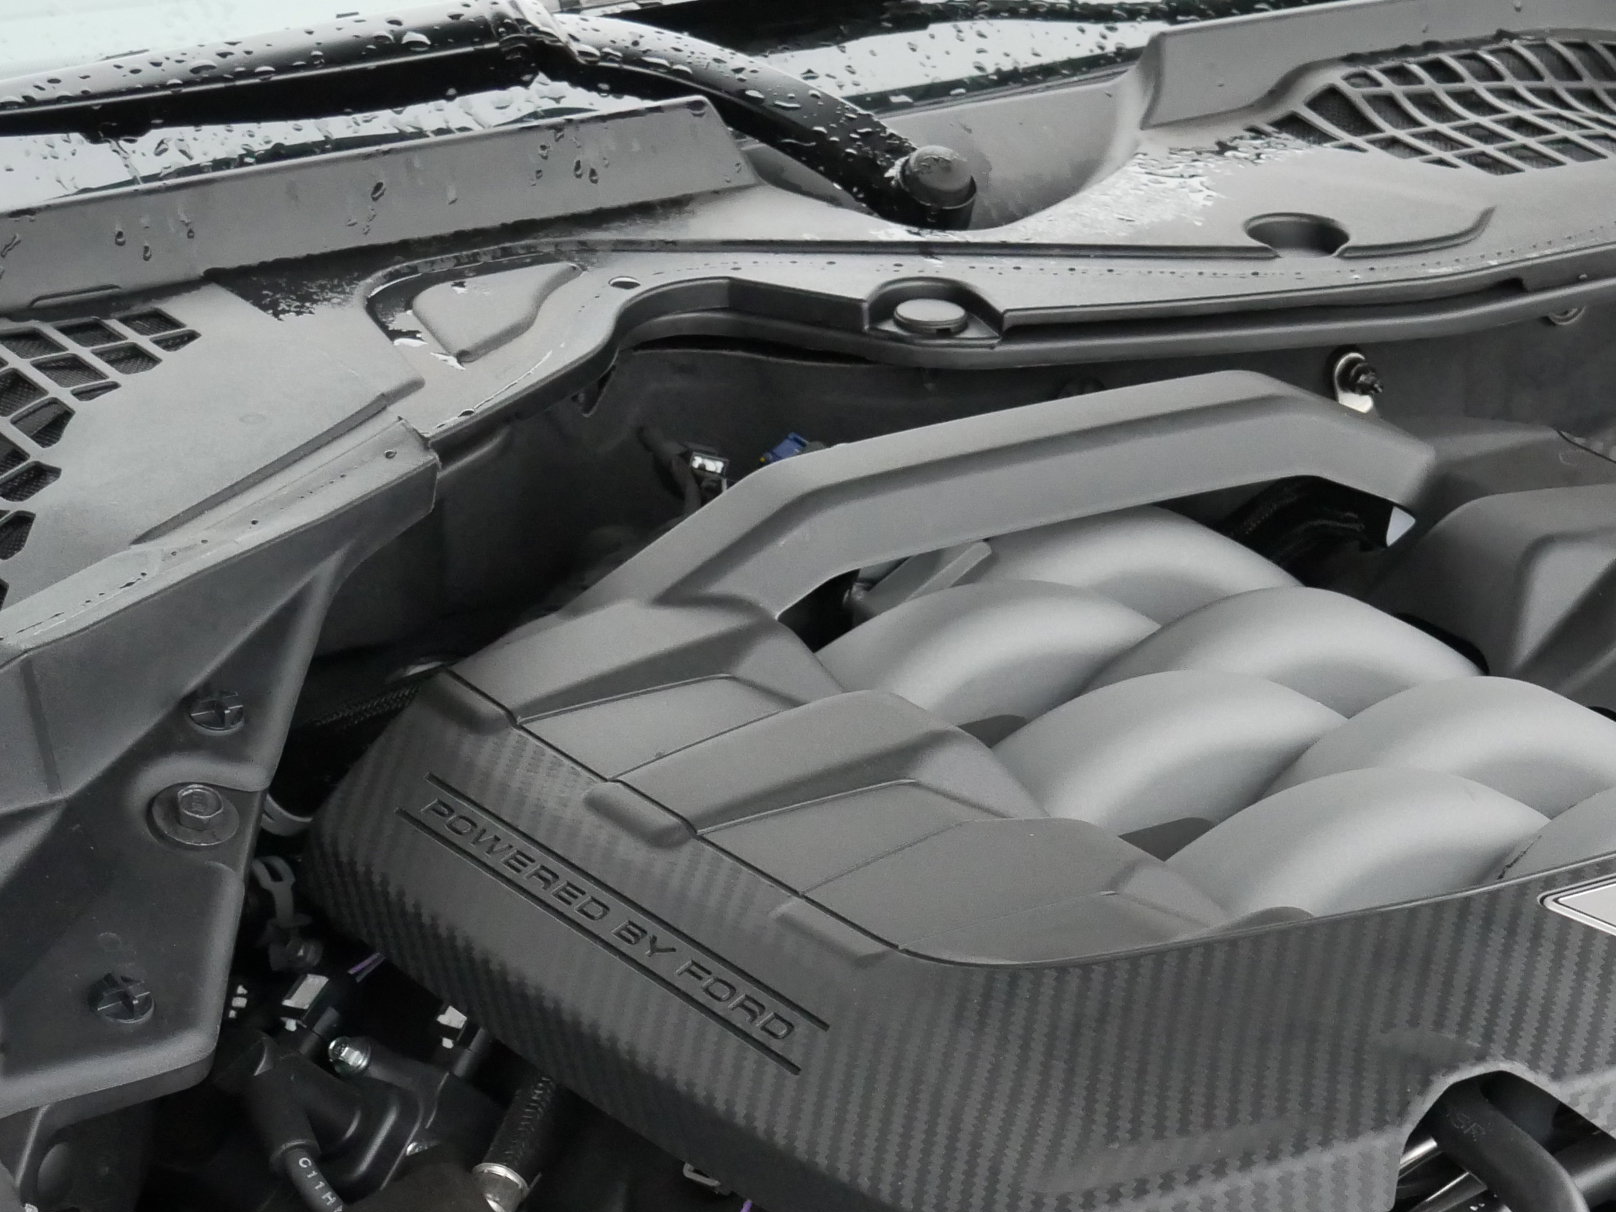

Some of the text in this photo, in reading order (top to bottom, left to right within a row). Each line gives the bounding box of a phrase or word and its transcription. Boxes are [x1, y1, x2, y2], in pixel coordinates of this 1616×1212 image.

[420, 798, 795, 1040] POWERED BY FORD
